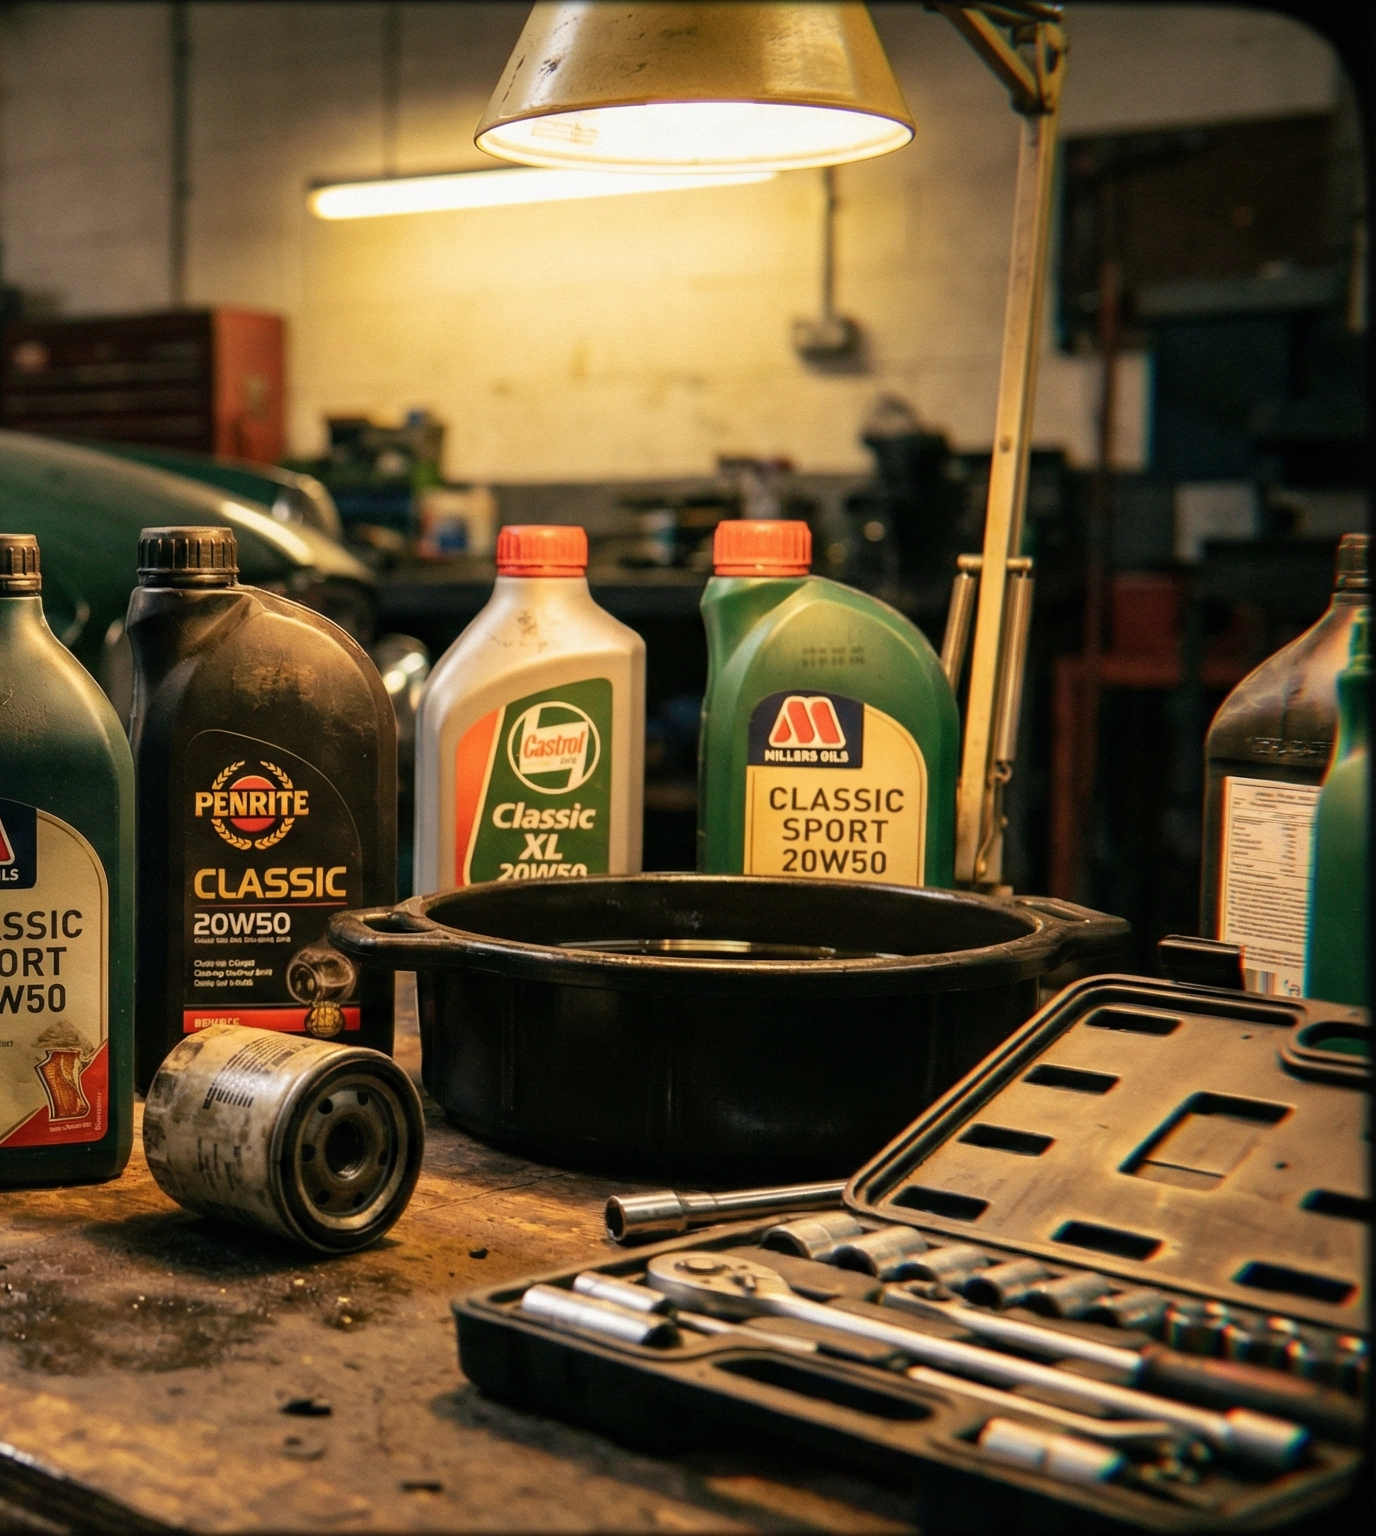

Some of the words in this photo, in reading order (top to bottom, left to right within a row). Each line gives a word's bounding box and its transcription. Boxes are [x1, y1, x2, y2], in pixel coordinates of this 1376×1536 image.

[524, 731, 585, 758] Castrol
[820, 750, 849, 763] OILS
[195, 790, 309, 816] PENRITE
[769, 787, 904, 813] CLASSIC
[492, 802, 596, 829] Classic
[782, 818, 889, 843] SPORT
[518, 833, 563, 860] XL
[782, 849, 886, 874] 20W50
[194, 867, 346, 899] CLASSIC
[193, 912, 291, 935] 20W50
